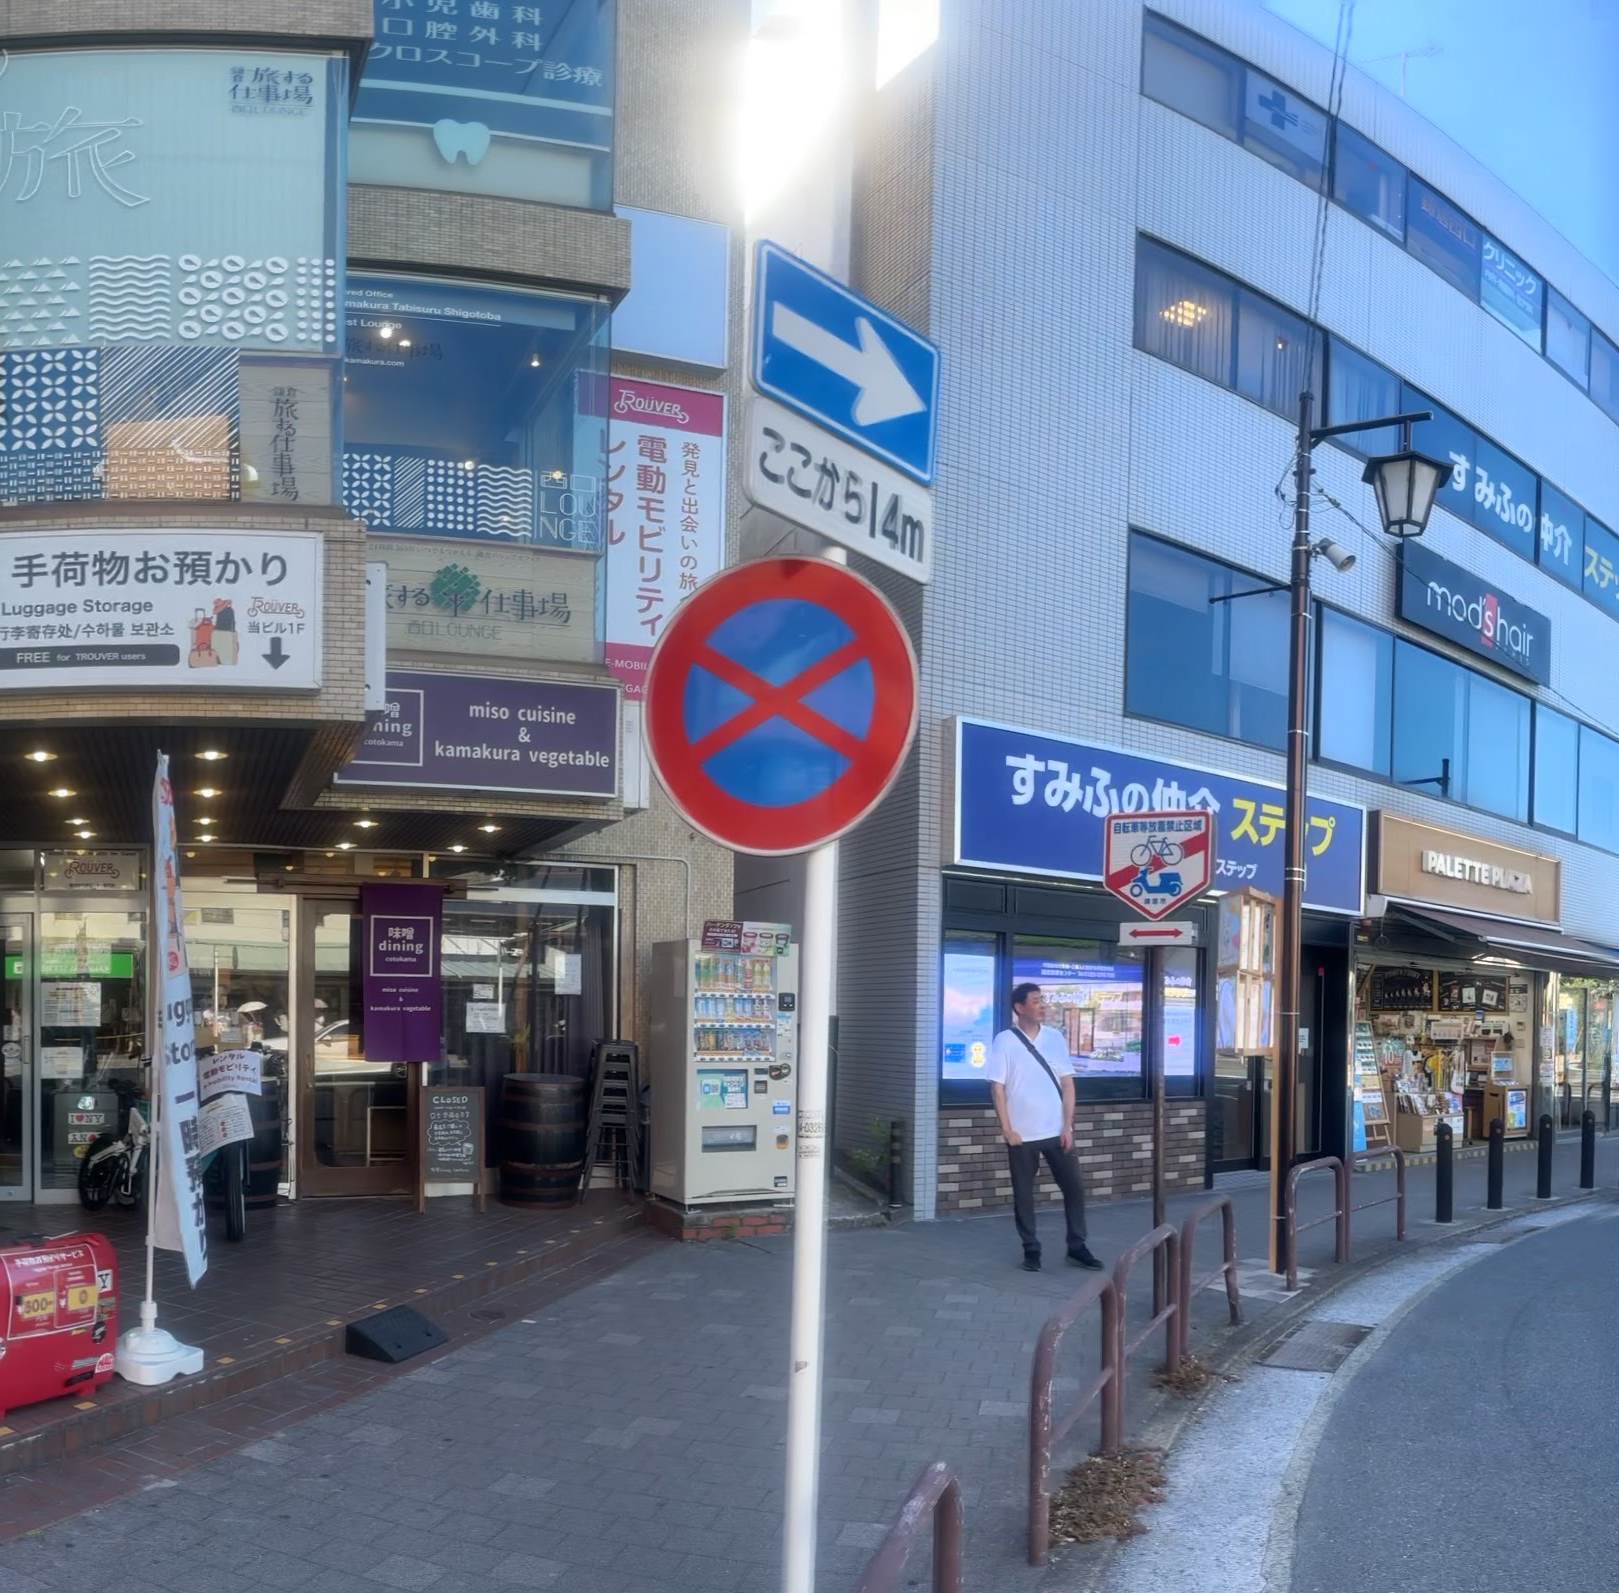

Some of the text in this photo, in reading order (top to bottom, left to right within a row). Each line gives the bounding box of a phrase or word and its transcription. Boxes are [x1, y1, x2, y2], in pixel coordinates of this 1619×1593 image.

[383, 17, 543, 51] 口腔外科
[251, 66, 313, 84] 旅する
[228, 84, 313, 105] 仕事場
[365, 290, 394, 299] Office
[392, 302, 502, 321] Tabisuru Shigotoba
[361, 319, 402, 330] Lounge
[268, 398, 299, 502] 旅する仕事場
[600, 428, 626, 546] レンタル
[759, 426, 925, 564] ここから14m
[541, 493, 597, 519] LOU
[1449, 450, 1573, 567] すみふの仲介
[540, 517, 596, 544] NGE
[635, 434, 667, 637] 電動モビリティ
[11, 550, 288, 589] 手荷物お預かり
[1, 598, 154, 618] Luggage Storage
[481, 588, 572, 624] 仕事場
[130, 622, 175, 637] 보관소
[247, 621, 305, 635] 当ビル1F
[407, 620, 503, 642] 西口LOUNGE
[1496, 607, 1534, 658] hair
[16, 652, 147, 664] FREE for TROUVER users
[469, 701, 576, 725] miso cuisine
[518, 727, 531, 743] &
[434, 740, 610, 768] kamakura vegetable
[1006, 753, 1221, 818] すみふの仲介
[1113, 819, 1203, 835] 自転車等放置禁止区域
[1216, 858, 1258, 880] ステップ
[1425, 850, 1534, 895] PALETTE PLAZA
[388, 927, 415, 941] 味噌
[378, 940, 424, 954] dining
[385, 955, 417, 963] cotokama
[402, 1005, 432, 1013] vegetable
[432, 1096, 468, 1104] CLOSED
